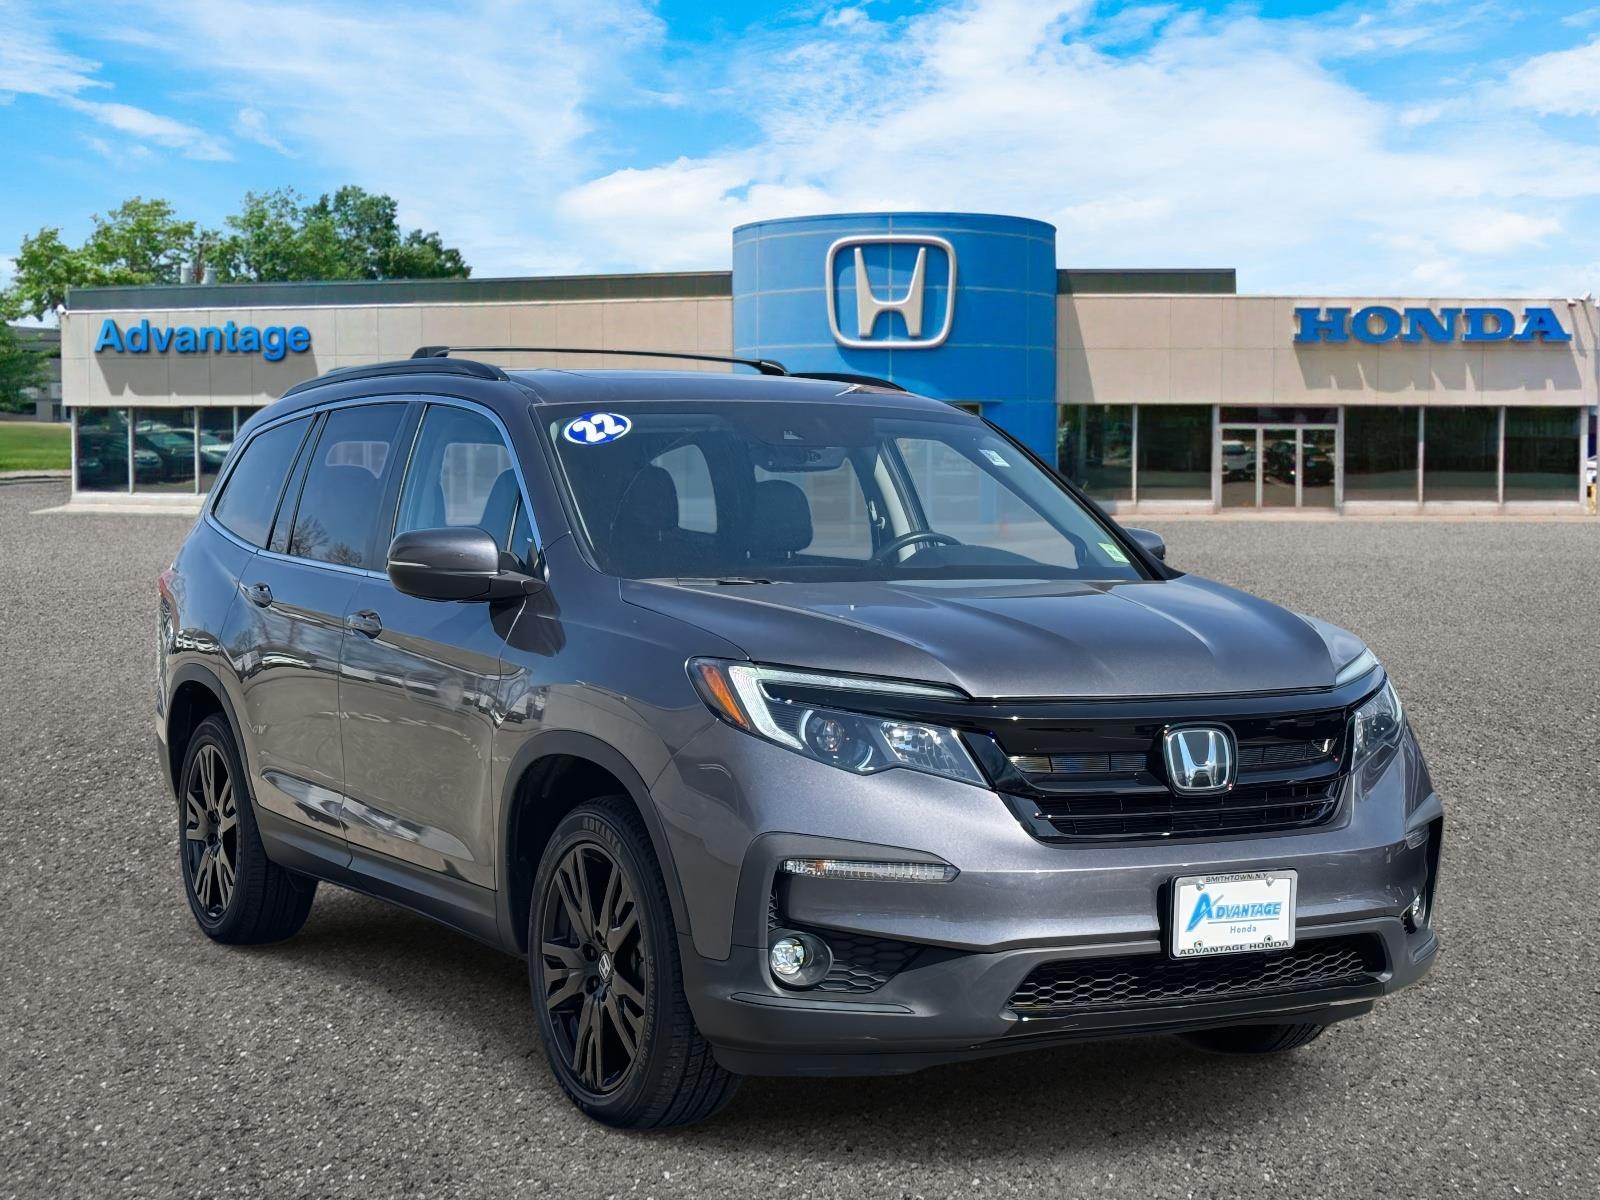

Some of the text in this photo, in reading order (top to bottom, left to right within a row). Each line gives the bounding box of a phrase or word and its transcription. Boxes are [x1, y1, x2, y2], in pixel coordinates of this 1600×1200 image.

[94, 318, 311, 361] Advantage
[1294, 305, 1572, 344] HONDA
[572, 413, 625, 443] 22
[1185, 892, 1281, 932] ADVANTAGE
[1230, 924, 1257, 934] Honda
[1179, 940, 1289, 956] ADVANTAGE HONDA
